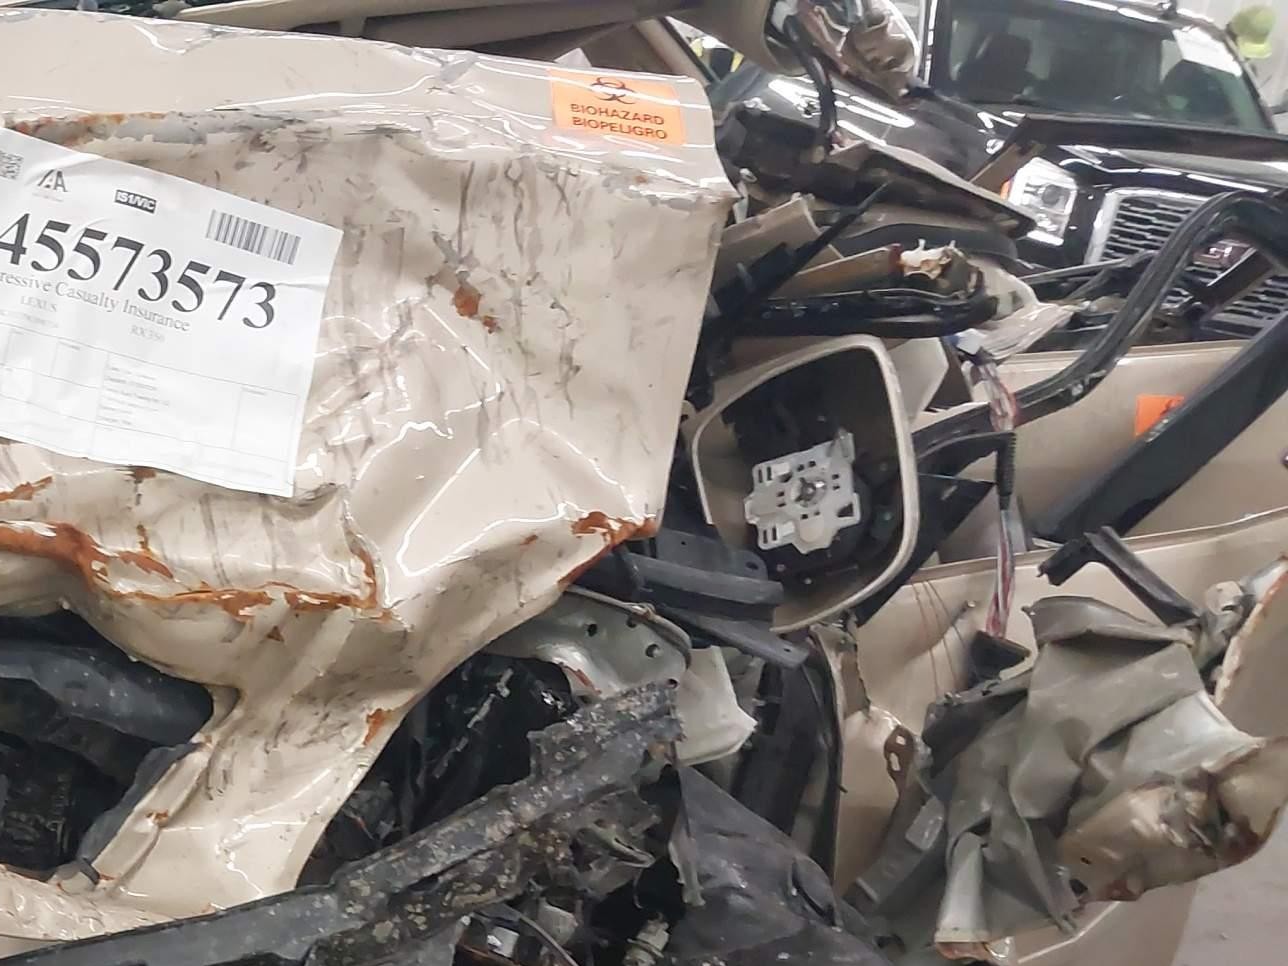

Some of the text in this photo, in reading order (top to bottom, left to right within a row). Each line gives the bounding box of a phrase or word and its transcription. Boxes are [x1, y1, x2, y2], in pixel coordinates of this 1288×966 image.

[570, 103, 665, 126] BIOHAZARD
[572, 116, 668, 139] BIOPELIGRO
[55, 281, 119, 313] Casualty
[122, 298, 191, 332] Insurance
